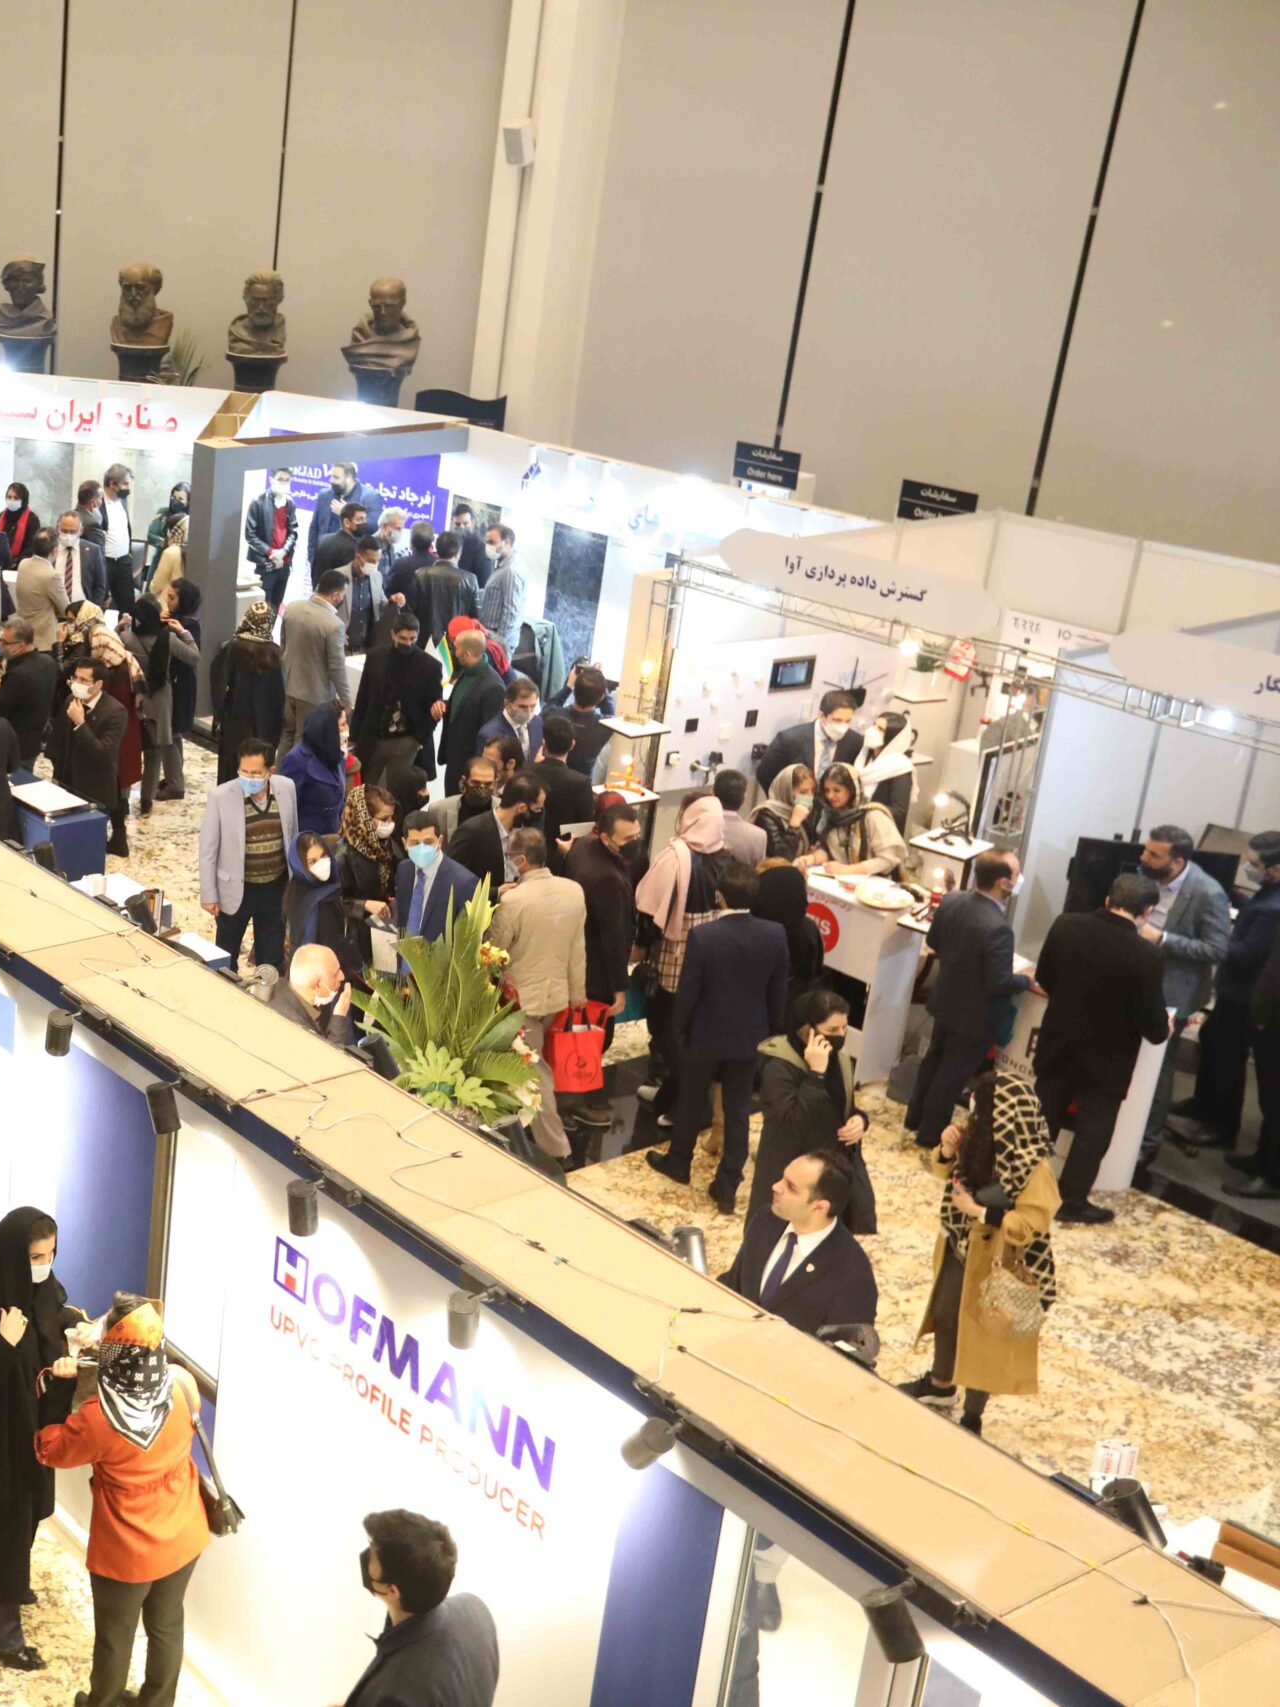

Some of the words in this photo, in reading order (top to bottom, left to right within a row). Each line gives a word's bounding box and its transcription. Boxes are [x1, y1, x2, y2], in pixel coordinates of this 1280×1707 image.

[46, 398, 102, 433] ایران
[746, 466, 767, 479] Order
[767, 471, 784, 483] here
[397, 486, 432, 509] فرجاد
[784, 555, 803, 575] آوا
[850, 575, 877, 590] داده
[273, 1235, 556, 1492] HOFMANN
[269, 1303, 321, 1362] UPVC
[329, 1353, 412, 1436] PROFILE
[419, 1422, 546, 1541] PRODUCER
